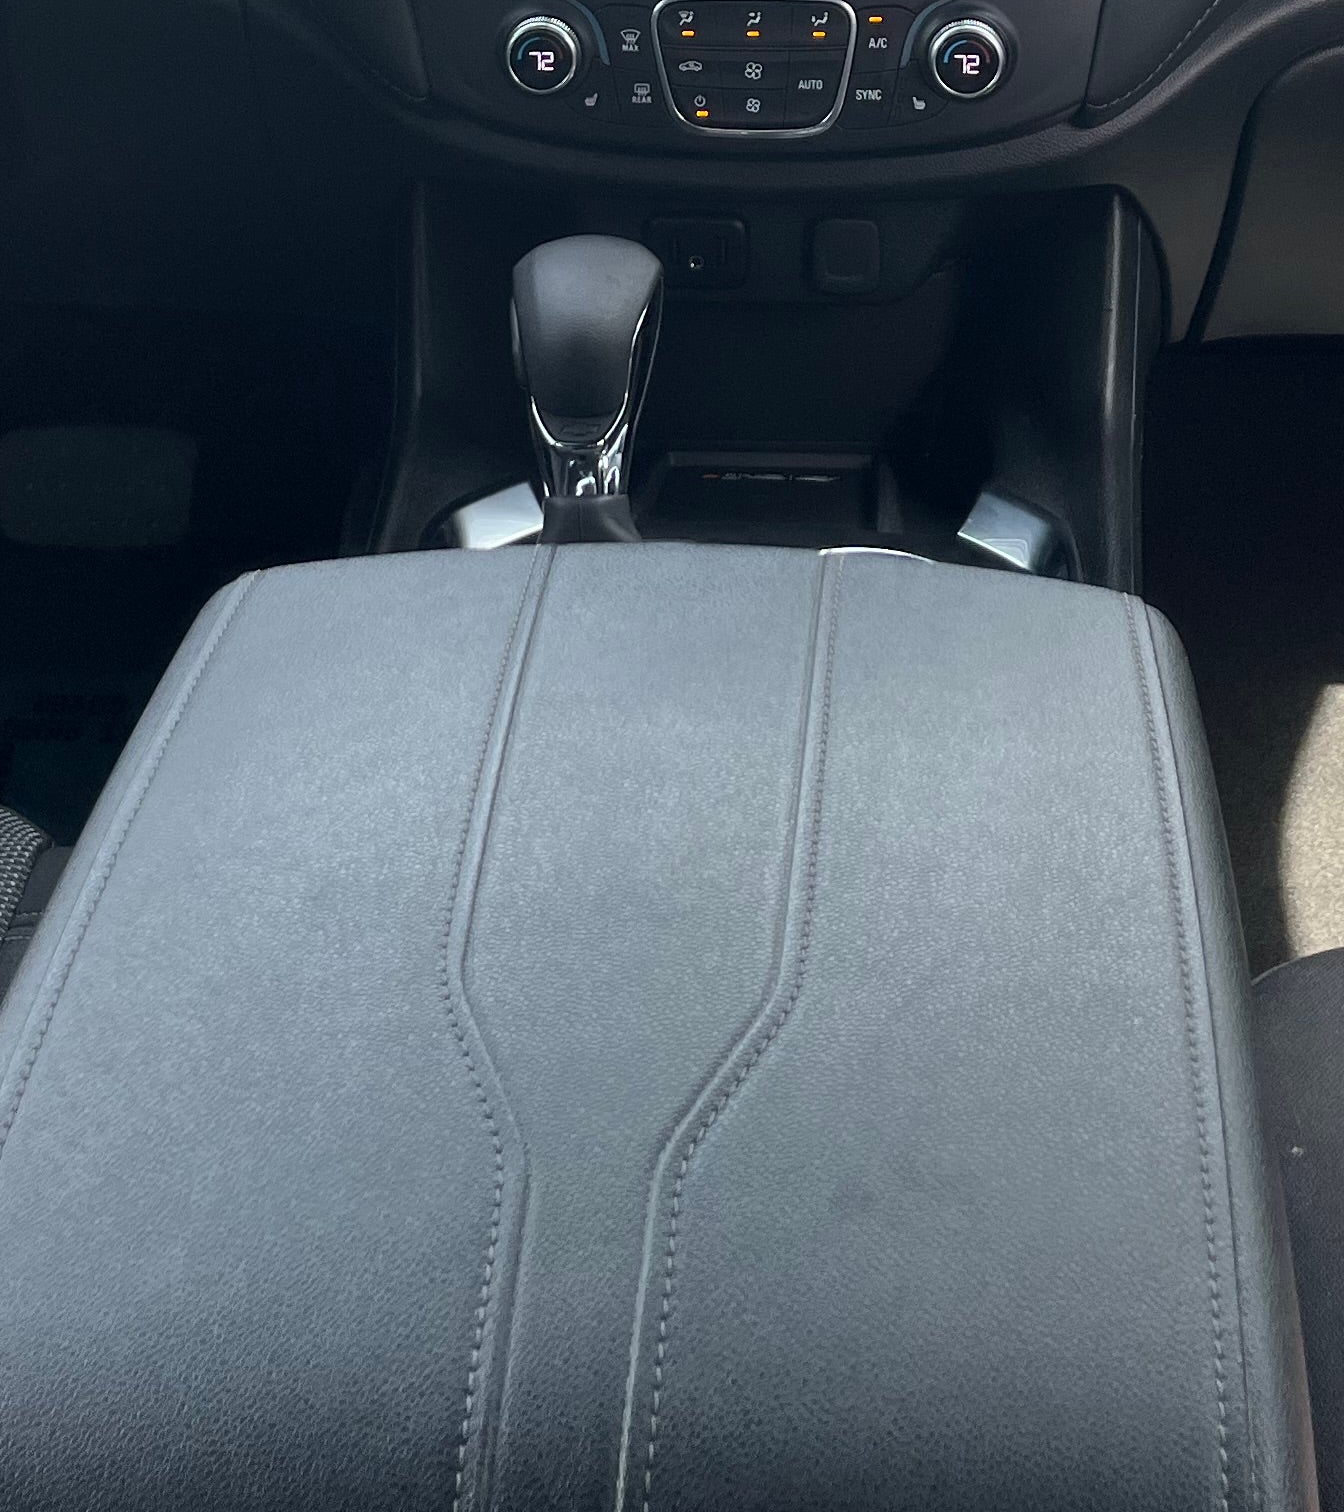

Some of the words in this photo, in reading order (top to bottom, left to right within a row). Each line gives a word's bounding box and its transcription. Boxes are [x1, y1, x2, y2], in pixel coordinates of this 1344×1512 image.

[621, 44, 640, 53] MAX
[868, 37, 888, 49] A/C
[528, 51, 555, 72] 72
[953, 54, 980, 75] 72
[798, 80, 824, 90] AUTO
[632, 96, 652, 104] REAR
[855, 89, 883, 101] SYNC
